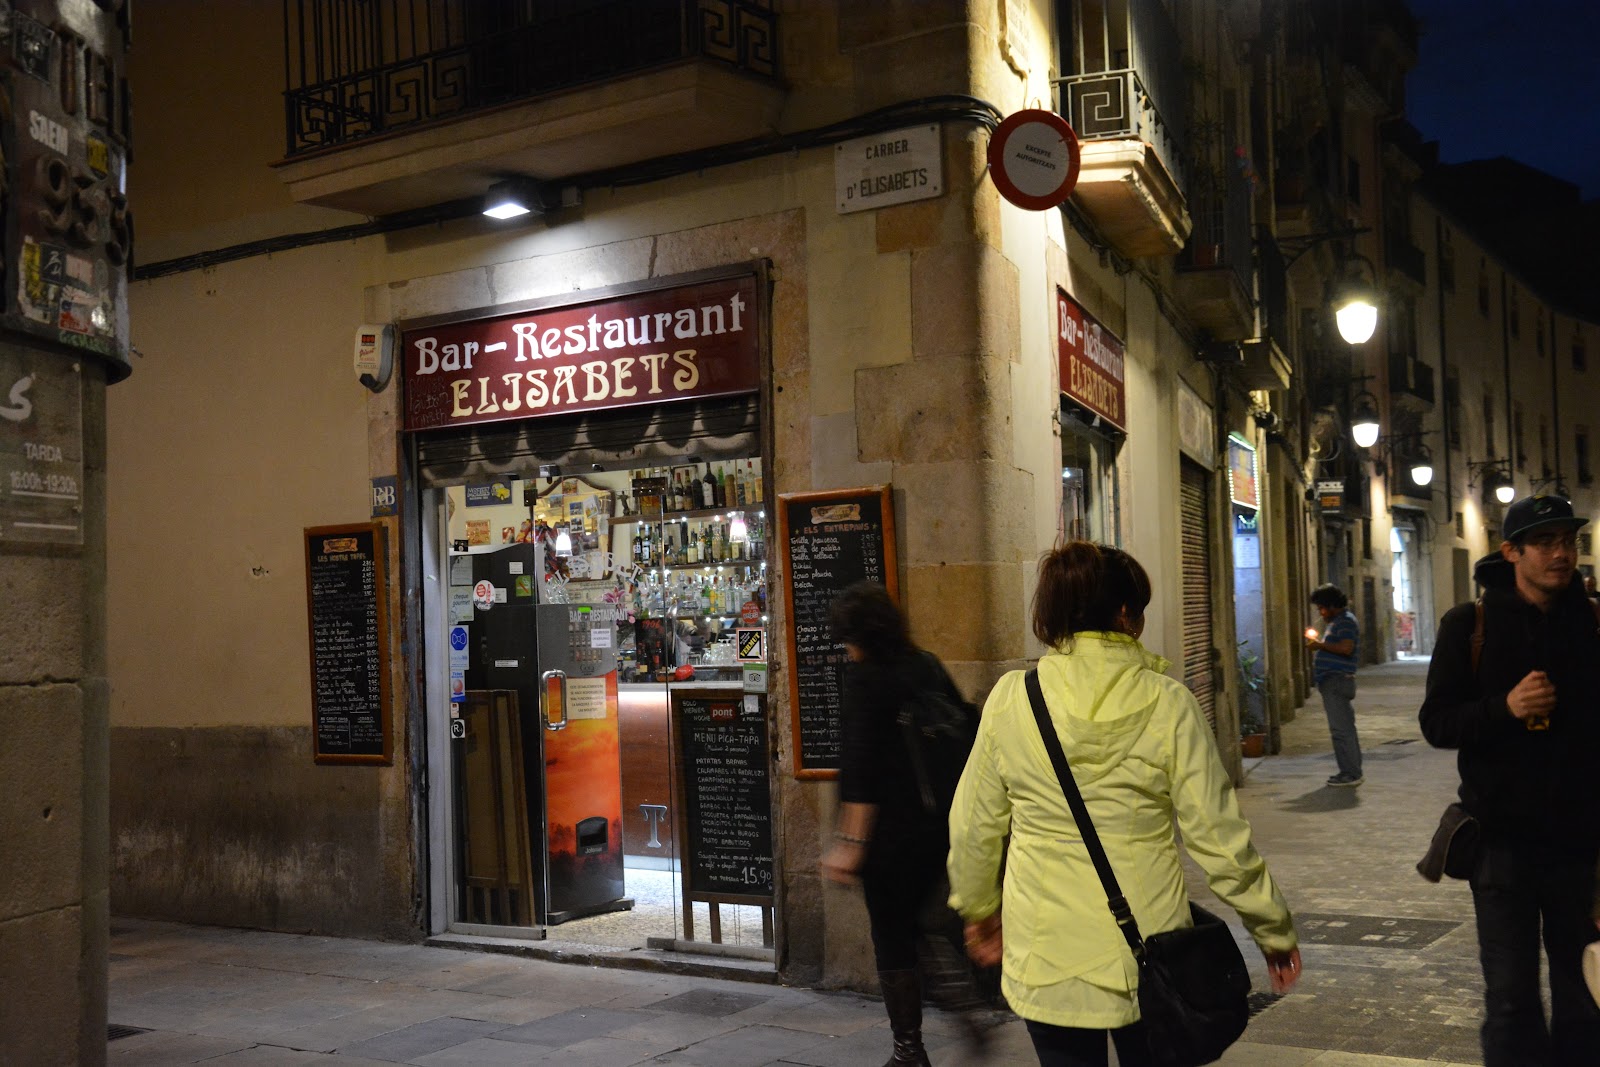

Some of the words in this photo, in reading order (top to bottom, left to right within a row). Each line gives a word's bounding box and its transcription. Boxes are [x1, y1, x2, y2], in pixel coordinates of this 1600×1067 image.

[865, 139, 909, 160] CARRER
[1025, 144, 1052, 158] EXCEPTE
[1015, 152, 1057, 171] AUTORITZATS
[449, 350, 702, 418] ELISABETS
[25, 443, 63, 463] TARDA
[803, 526, 819, 535] ELS
[569, 611, 582, 622] BAR
[589, 607, 628, 622] RESTAURANT
[739, 632, 761, 657] VERMUT
[683, 706, 706, 714] VIERNES
[712, 708, 733, 717] pont
[694, 732, 716, 743] MENU
[696, 767, 729, 775] CALAMARES
